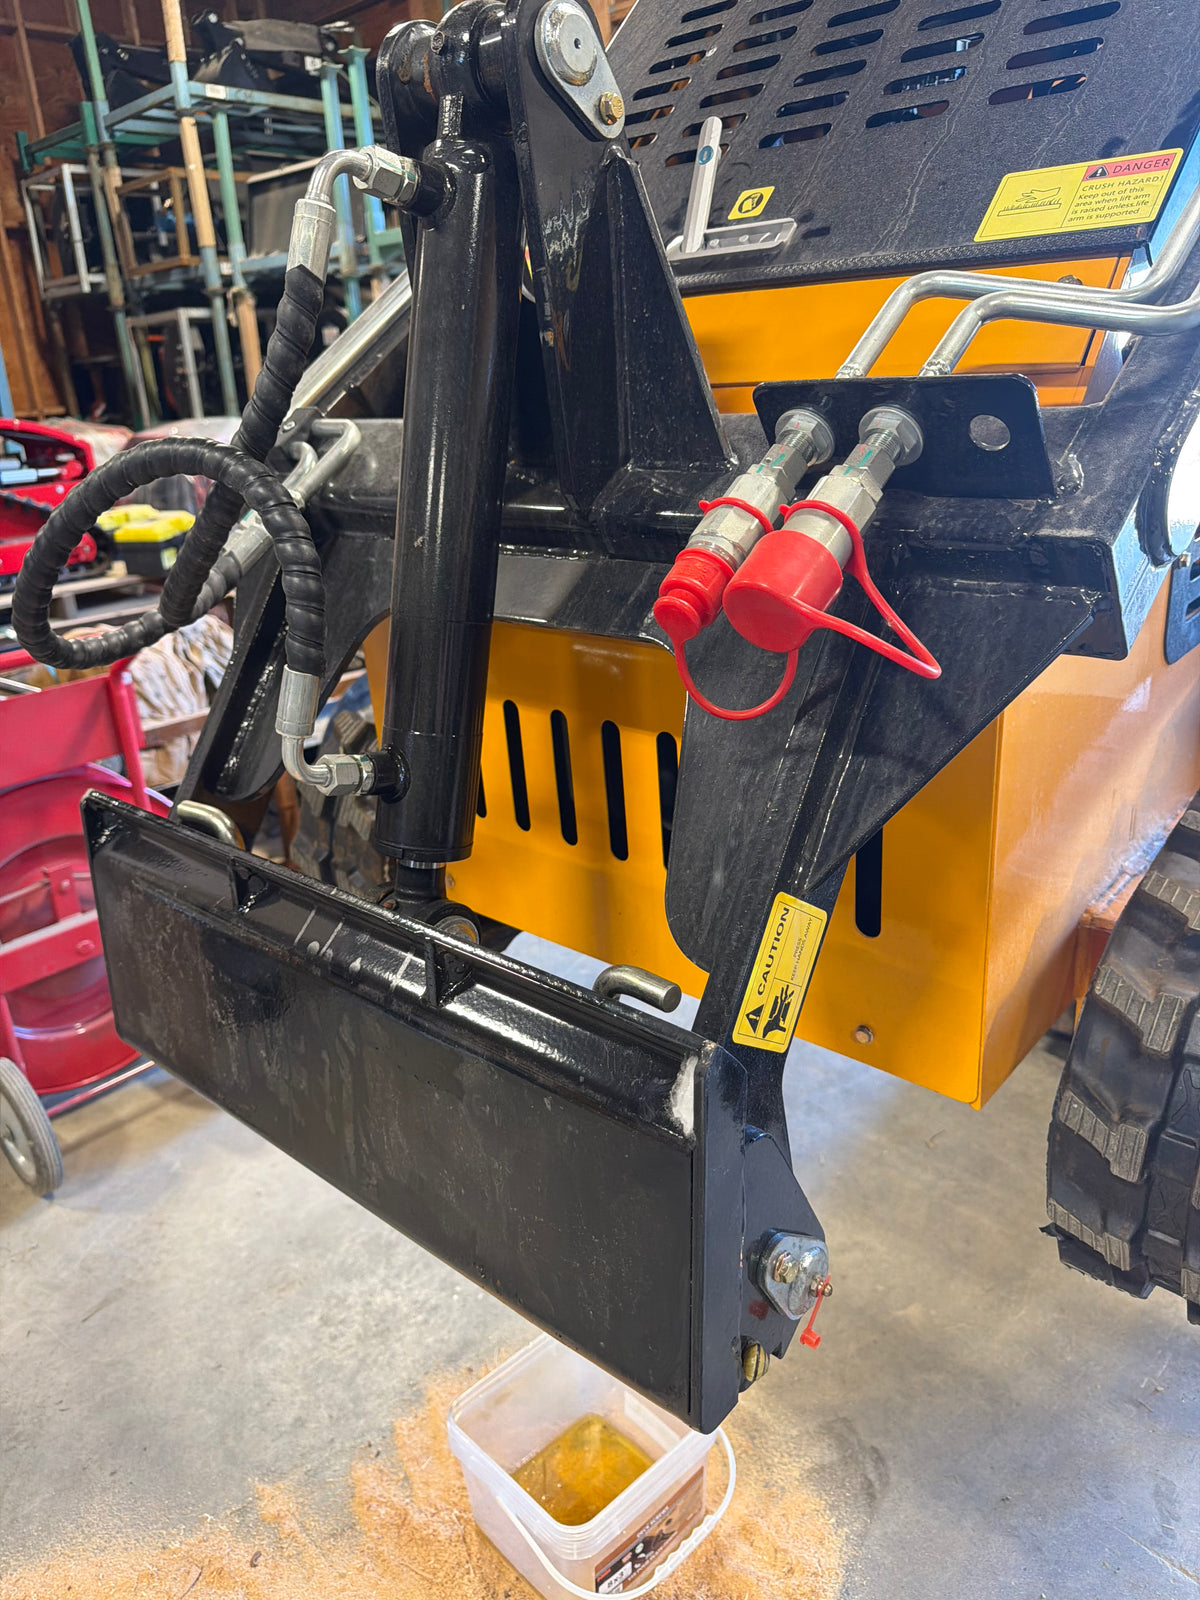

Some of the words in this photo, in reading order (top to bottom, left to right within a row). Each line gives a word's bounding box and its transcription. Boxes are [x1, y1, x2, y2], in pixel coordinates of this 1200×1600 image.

[1113, 158, 1170, 174] DANGER
[1082, 182, 1115, 192] CRUSH
[1118, 175, 1164, 187] HAZARD!
[1074, 200, 1093, 208] area
[1095, 197, 1118, 206] when
[1120, 194, 1131, 202] lift
[1133, 193, 1151, 201] arm
[1078, 193, 1099, 201] Keep
[1101, 190, 1115, 198] out
[1117, 187, 1128, 195] of
[1129, 186, 1144, 194] this
[1079, 205, 1106, 214] raised
[1094, 208, 1140, 219] supported
[803, 917, 813, 938] AWAY
[757, 907, 790, 996] CAUTION
